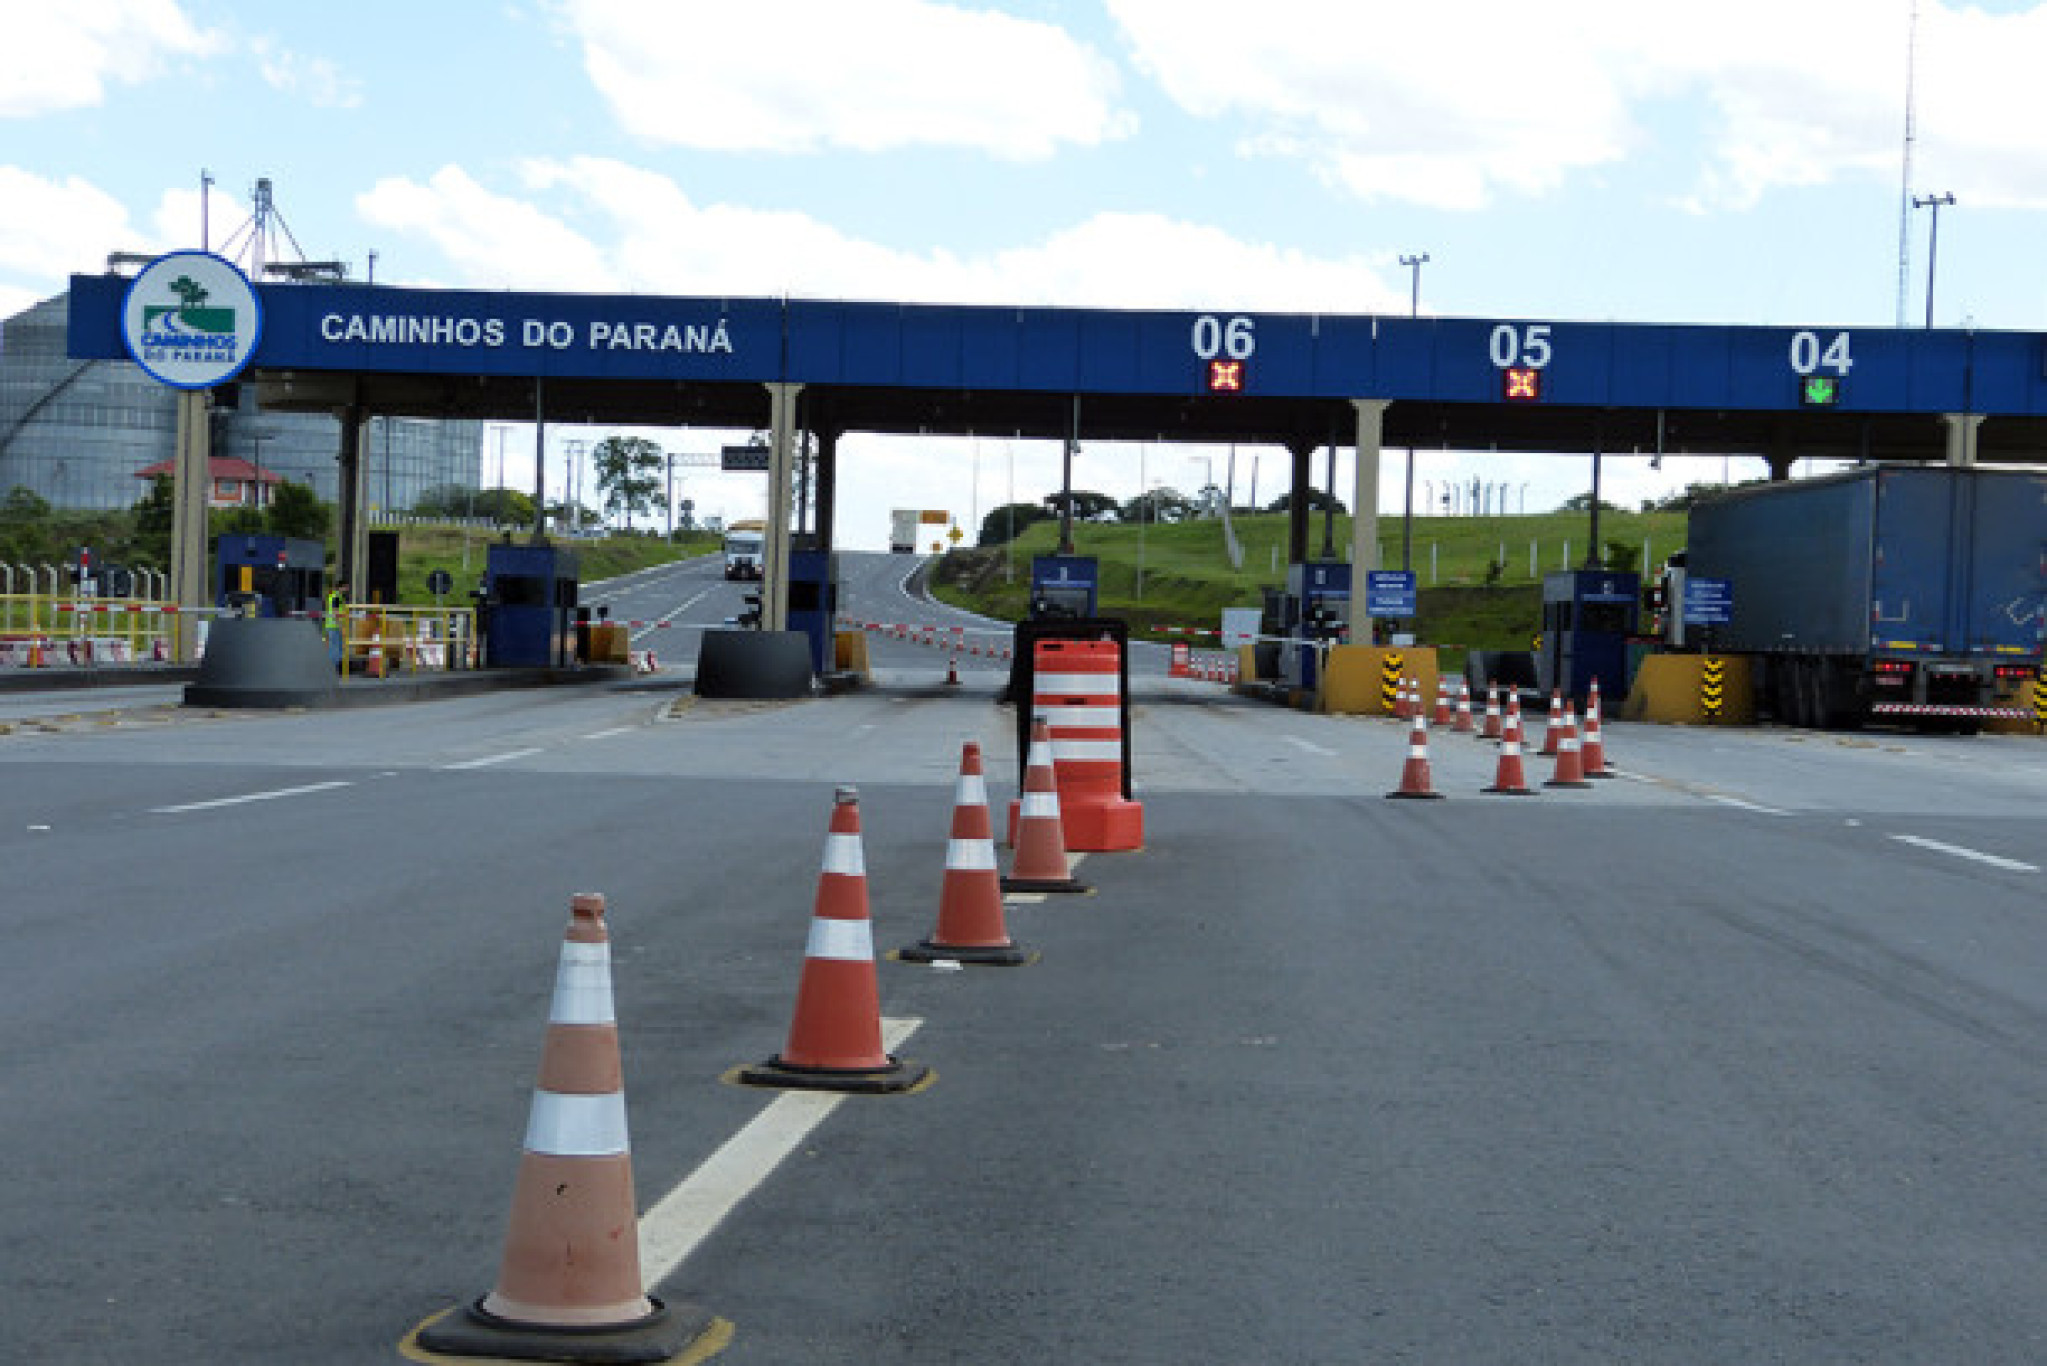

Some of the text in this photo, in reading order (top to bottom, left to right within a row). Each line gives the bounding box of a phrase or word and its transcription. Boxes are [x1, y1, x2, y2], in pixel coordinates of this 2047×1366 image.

[321, 313, 733, 353] CAMINHOS DO PARANÁ
[1192, 315, 1255, 360] 06
[1489, 325, 1552, 369] 05
[1790, 331, 1853, 376] 04
